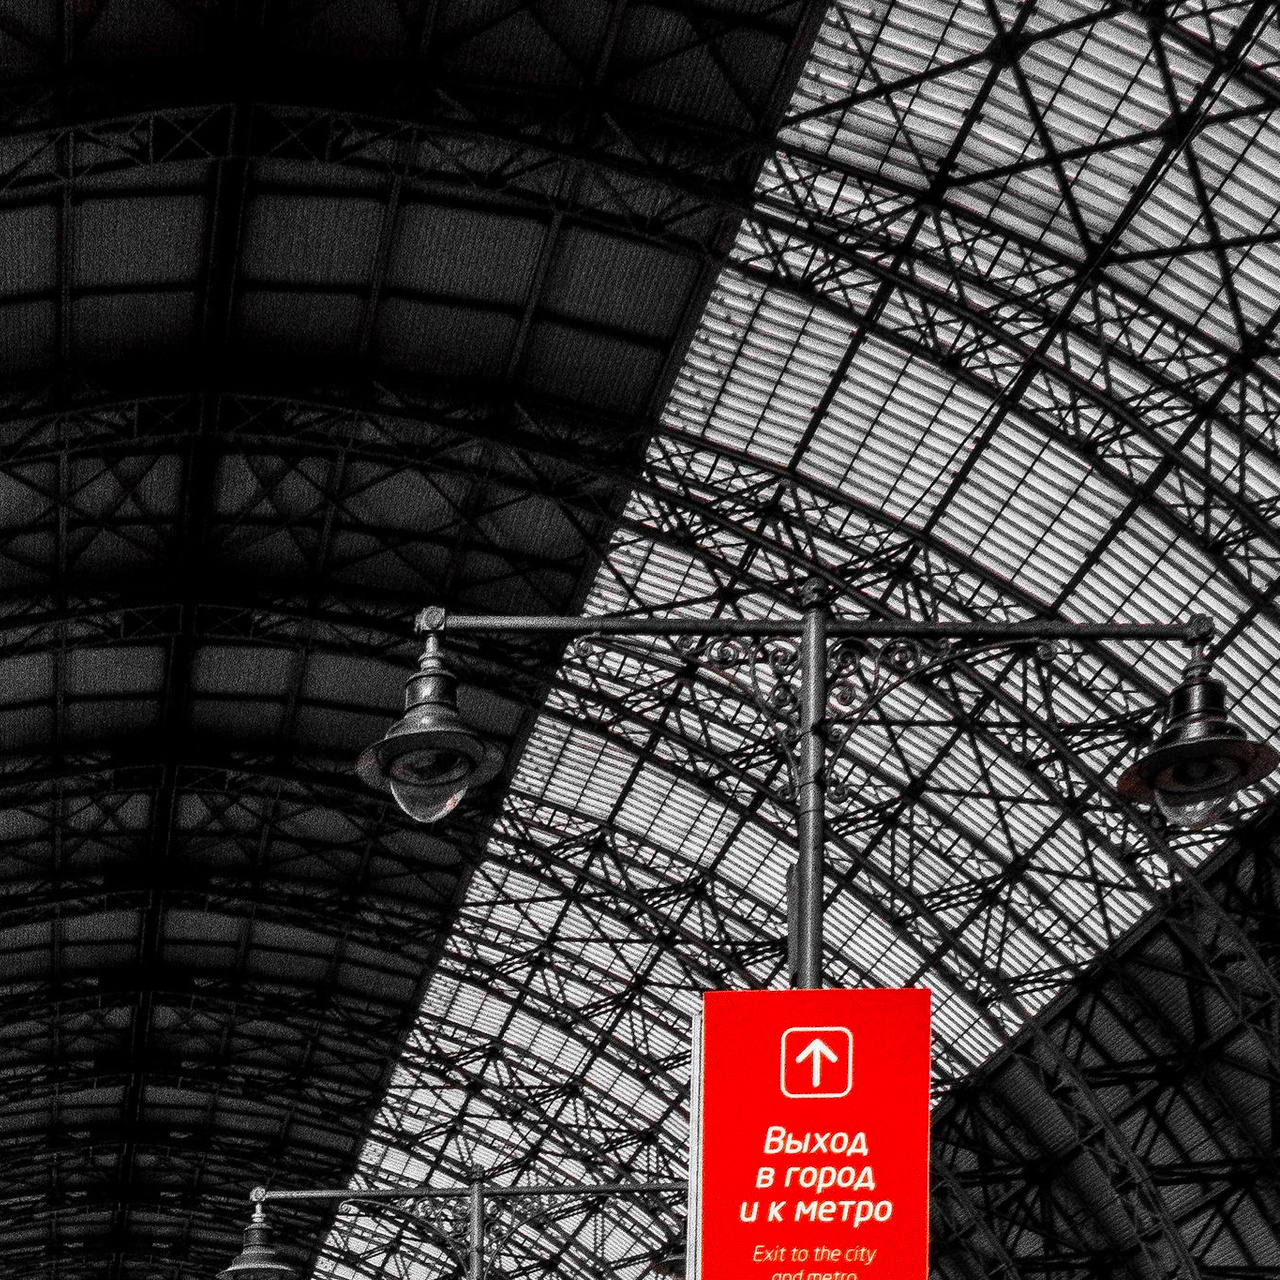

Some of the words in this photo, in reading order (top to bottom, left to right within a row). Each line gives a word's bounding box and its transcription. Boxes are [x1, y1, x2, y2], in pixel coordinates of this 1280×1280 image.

[763, 1125, 869, 1156] Выход
[755, 1167, 775, 1188] в
[784, 1166, 876, 1194] город
[739, 1201, 759, 1223] и
[767, 1201, 785, 1222] к
[794, 1199, 893, 1228] метро
[752, 1245, 785, 1263] Exit
[791, 1246, 808, 1263] to
[814, 1245, 841, 1262] the
[845, 1245, 877, 1266] city
